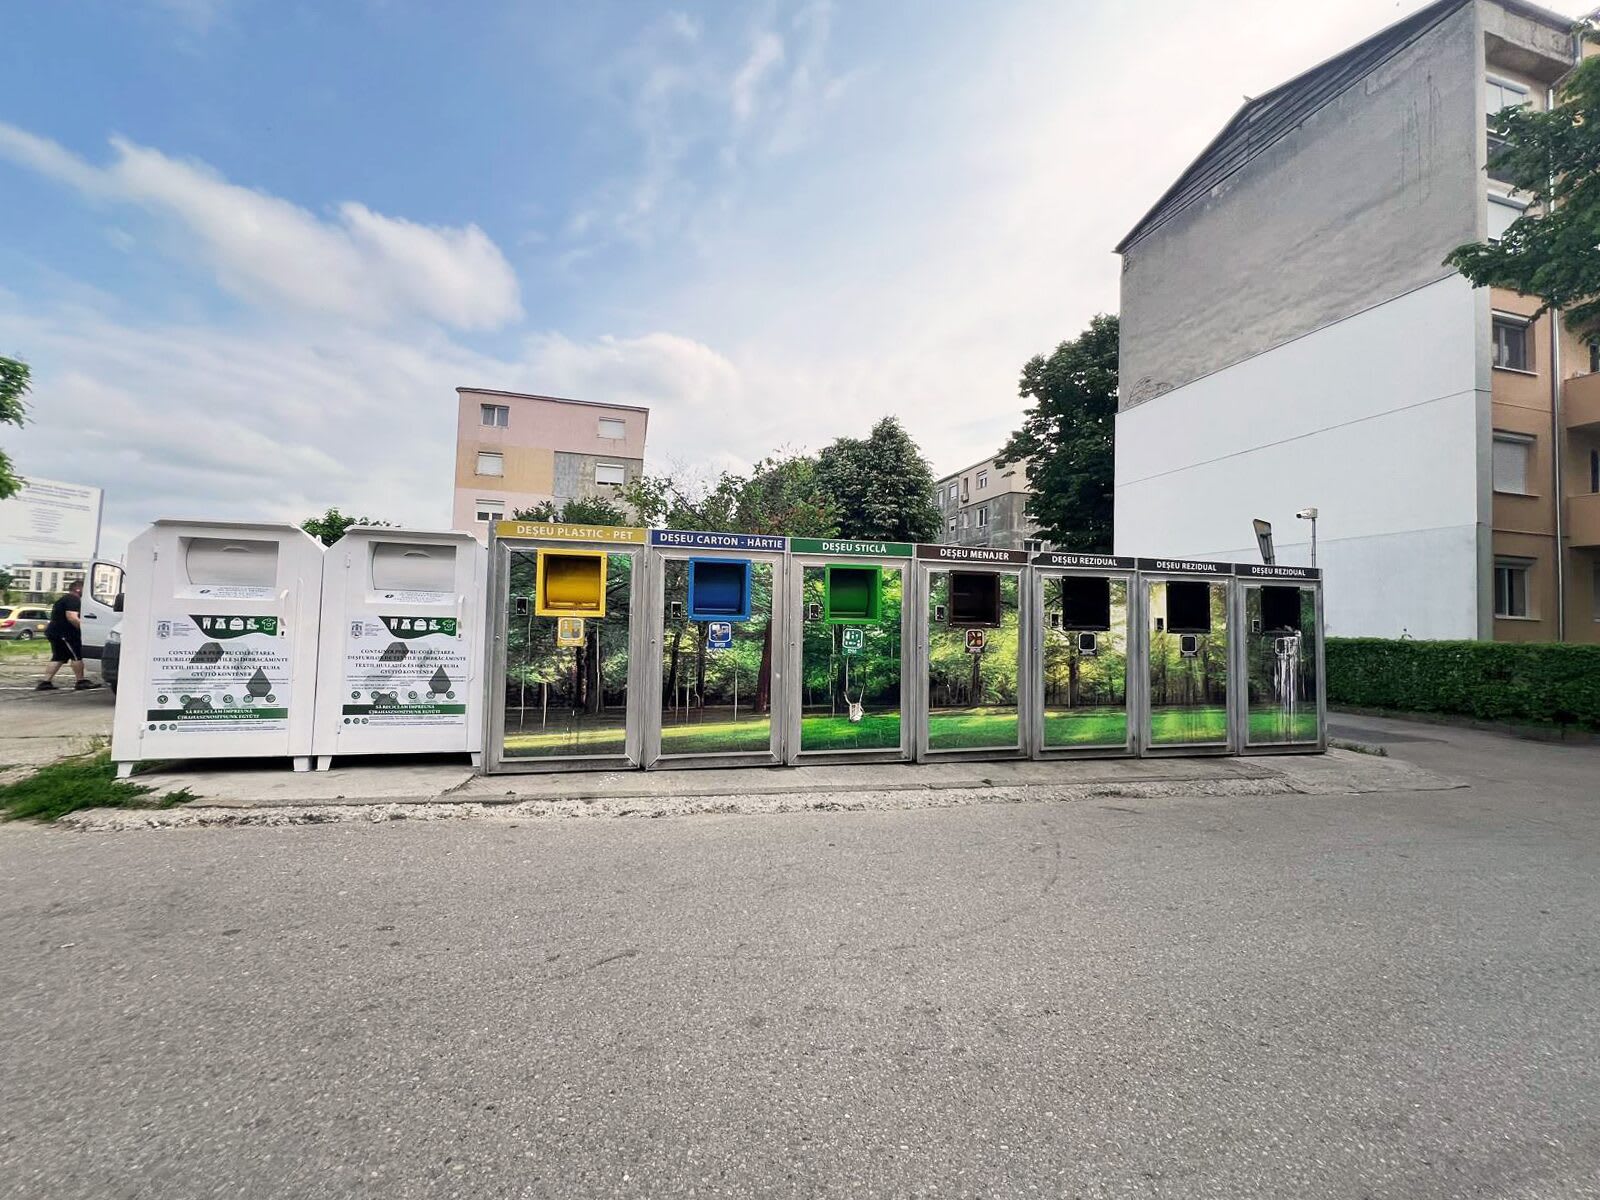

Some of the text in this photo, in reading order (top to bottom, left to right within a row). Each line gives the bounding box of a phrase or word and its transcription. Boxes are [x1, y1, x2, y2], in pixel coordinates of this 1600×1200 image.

[517, 525, 554, 537] DEȘEU
[557, 527, 604, 538] PLASTIC
[613, 530, 634, 540] PET
[660, 533, 694, 544] DEȘEU
[696, 535, 738, 546] CARTON
[822, 542, 887, 554] DEȘEU STICLĂ
[940, 549, 1010, 561] DEȘEU MENAJER
[1051, 555, 1118, 566] DEȘEU REZIDUAL
[1156, 561, 1217, 571] DEȘEU REZIDUAL
[1252, 566, 1306, 577] DEȘEU REZIDUAL
